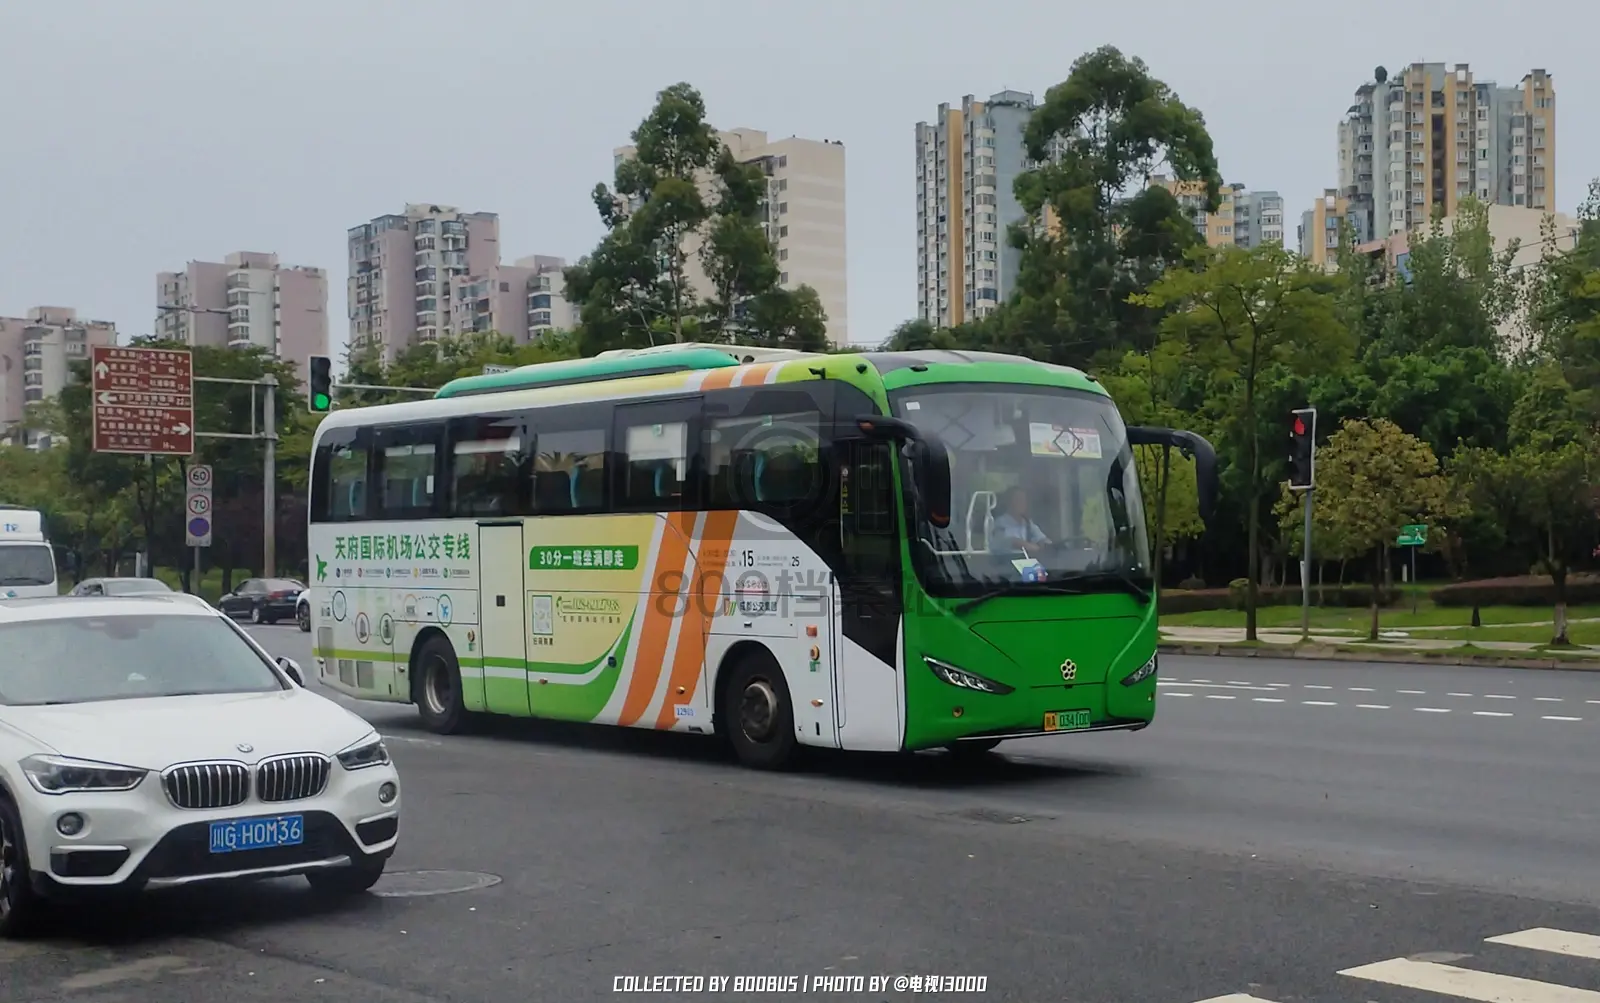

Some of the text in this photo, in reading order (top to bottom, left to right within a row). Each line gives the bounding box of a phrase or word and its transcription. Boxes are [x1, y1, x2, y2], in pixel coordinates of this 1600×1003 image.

[193, 471, 206, 481] 60
[193, 499, 206, 510] 70
[335, 533, 470, 560] 天府国际机场公交专线
[539, 549, 624, 567] 30分一班坐满即走
